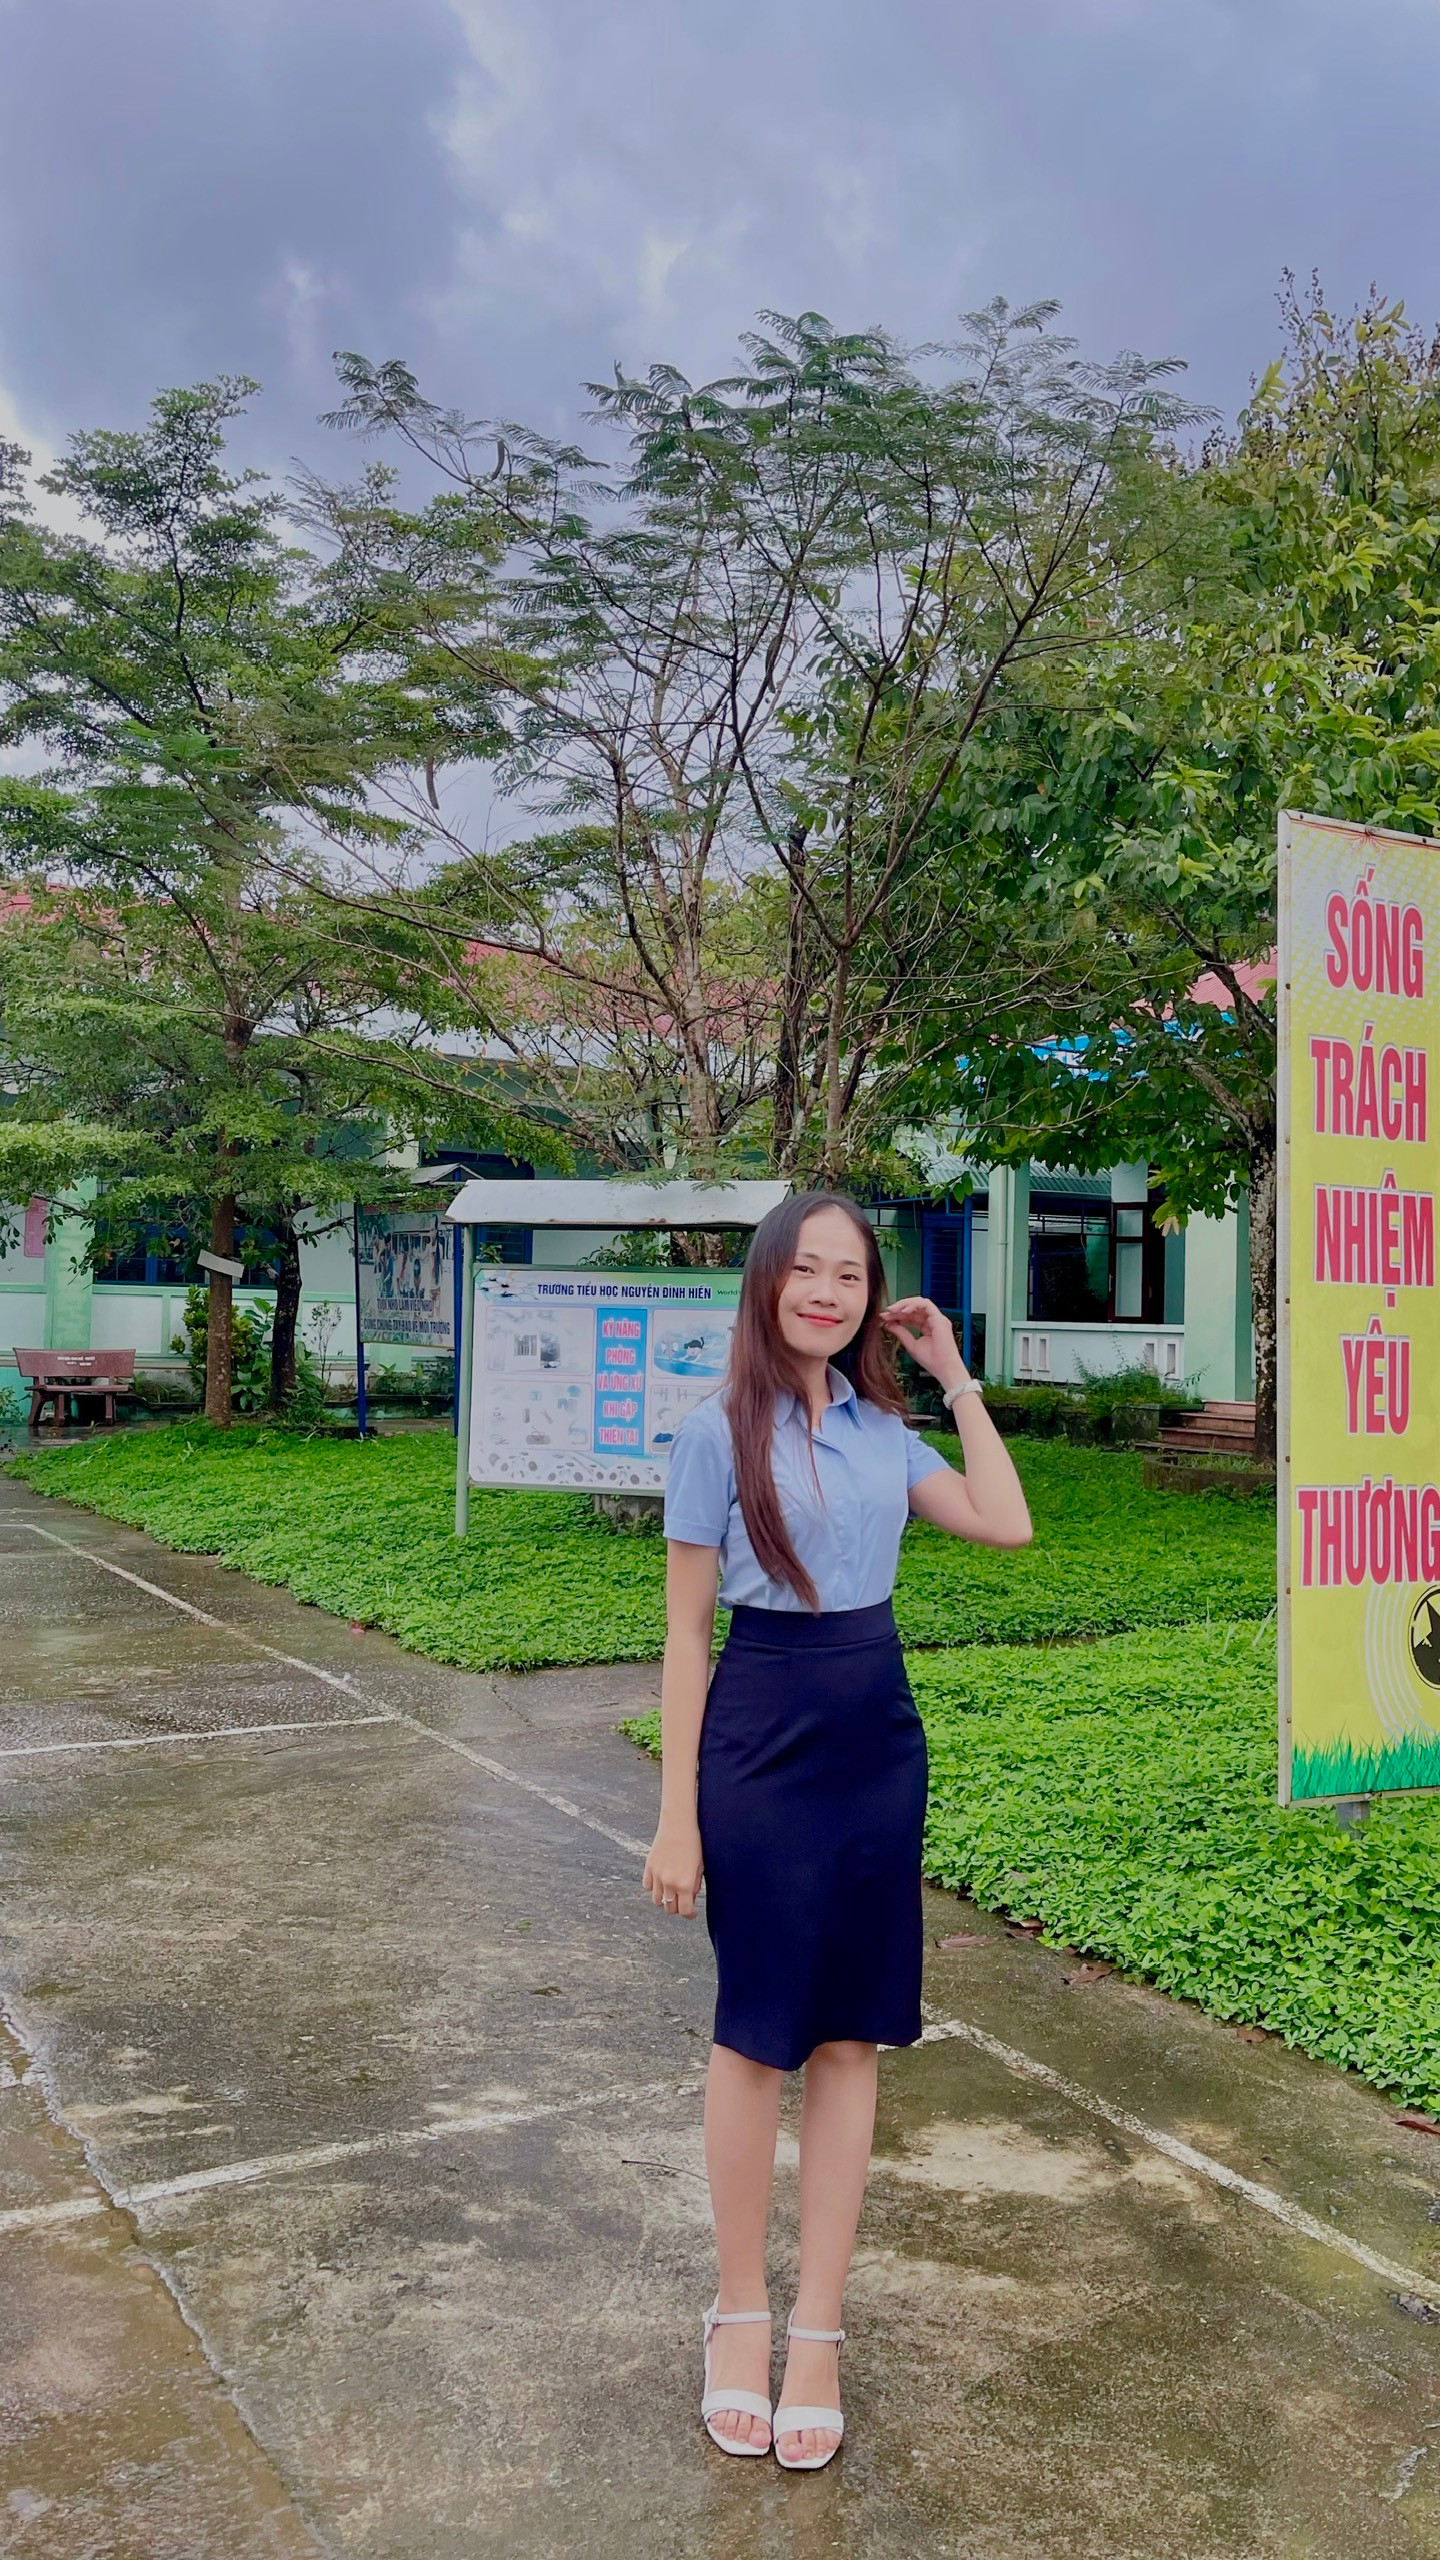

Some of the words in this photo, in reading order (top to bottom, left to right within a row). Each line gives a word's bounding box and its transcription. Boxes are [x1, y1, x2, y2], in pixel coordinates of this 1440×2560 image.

[1325, 864, 1424, 999] SỐNG
[1309, 1022, 1427, 1143] TRÁCH
[600, 1286, 618, 1299] HỌC
[621, 1282, 660, 1298] NGUYỄN
[662, 1284, 686, 1299] ĐÌNH
[1314, 1170, 1435, 1308] NHIỆM
[603, 1400, 618, 1418] KHI
[605, 1344, 636, 1365] PHÒNG
[1342, 1317, 1411, 1434] YÊU
[599, 1425, 625, 1445] THIÊN
[625, 1428, 639, 1446] TAI
[1297, 1477, 1440, 1586] THƯƠNG
